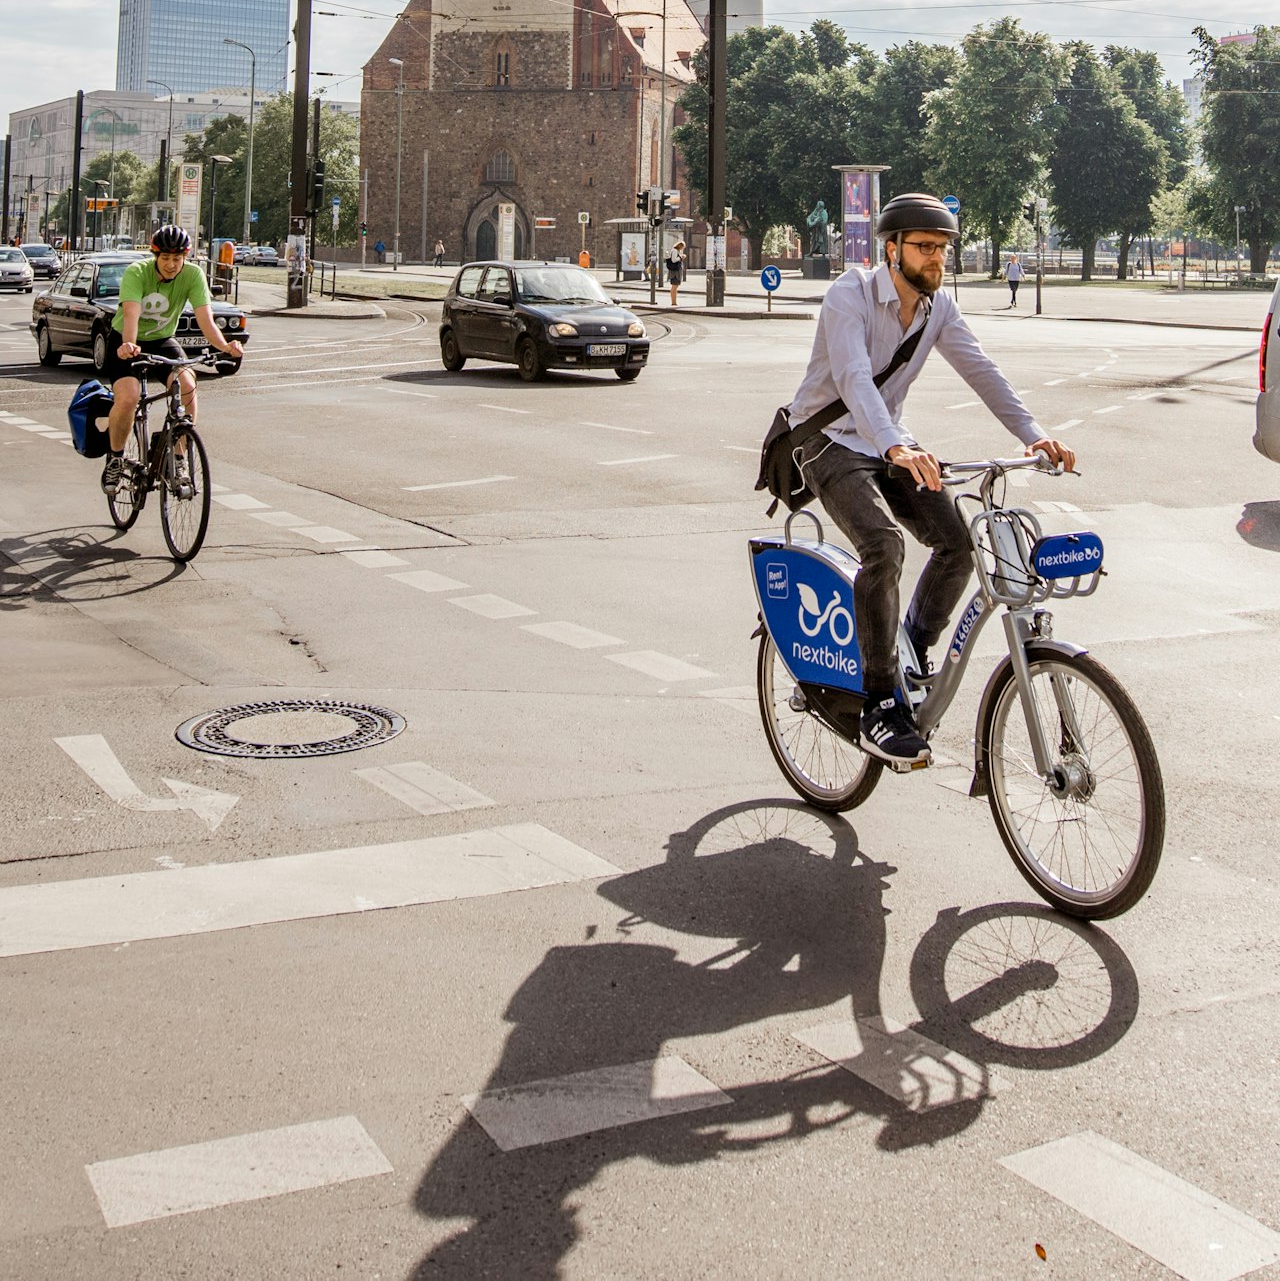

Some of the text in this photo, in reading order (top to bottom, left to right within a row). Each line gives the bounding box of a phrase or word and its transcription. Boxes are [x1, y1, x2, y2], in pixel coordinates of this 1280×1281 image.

[599, 345, 609, 354] KH
[609, 345, 625, 354] 7155
[1038, 550, 1084, 567] nextbike
[768, 570, 783, 582] Rent
[774, 580, 787, 591] App!
[953, 607, 977, 648] 14652
[792, 642, 858, 677] nextbike
